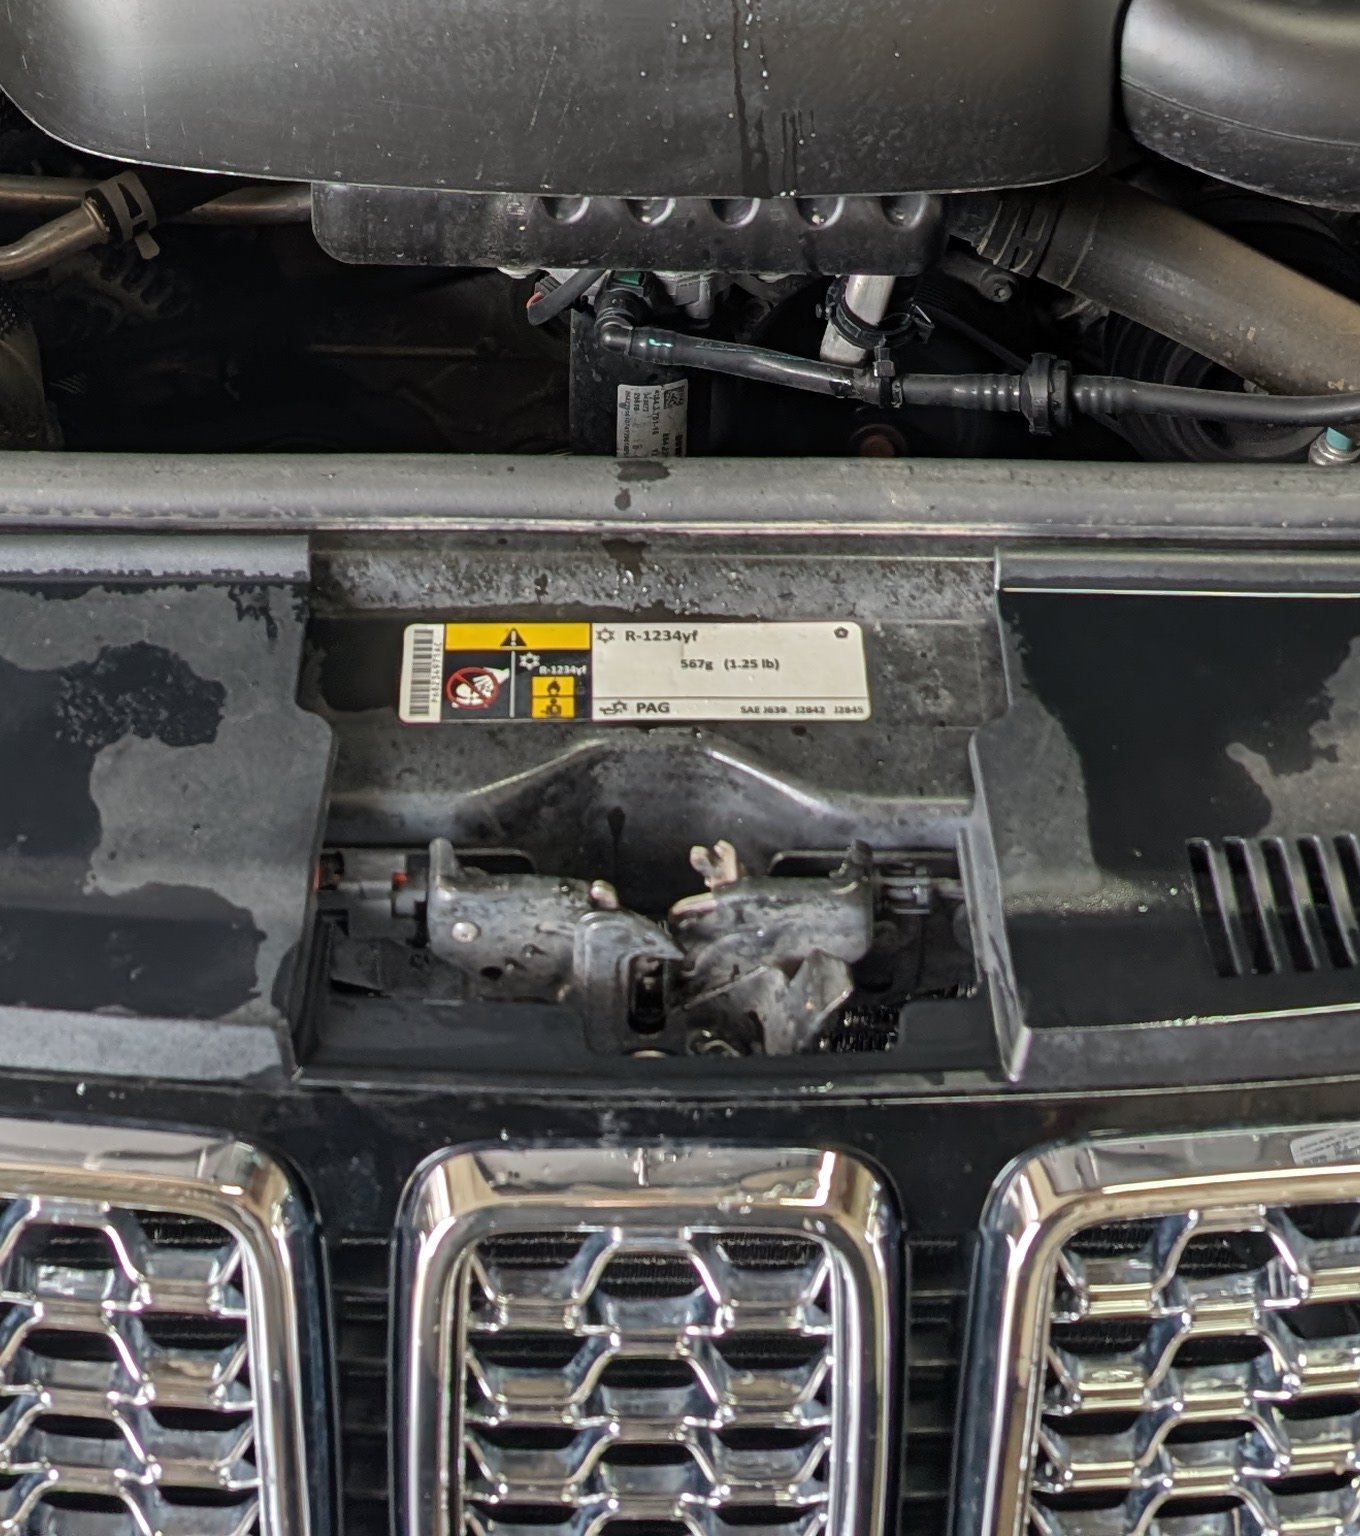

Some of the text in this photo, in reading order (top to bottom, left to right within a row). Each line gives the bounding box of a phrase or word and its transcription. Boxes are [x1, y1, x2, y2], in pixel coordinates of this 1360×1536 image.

[625, 629, 698, 645] R-1234yf
[538, 664, 587, 676] R-1234yf
[680, 658, 780, 671] 567g (1.25 lb)
[636, 702, 670, 714] PAG
